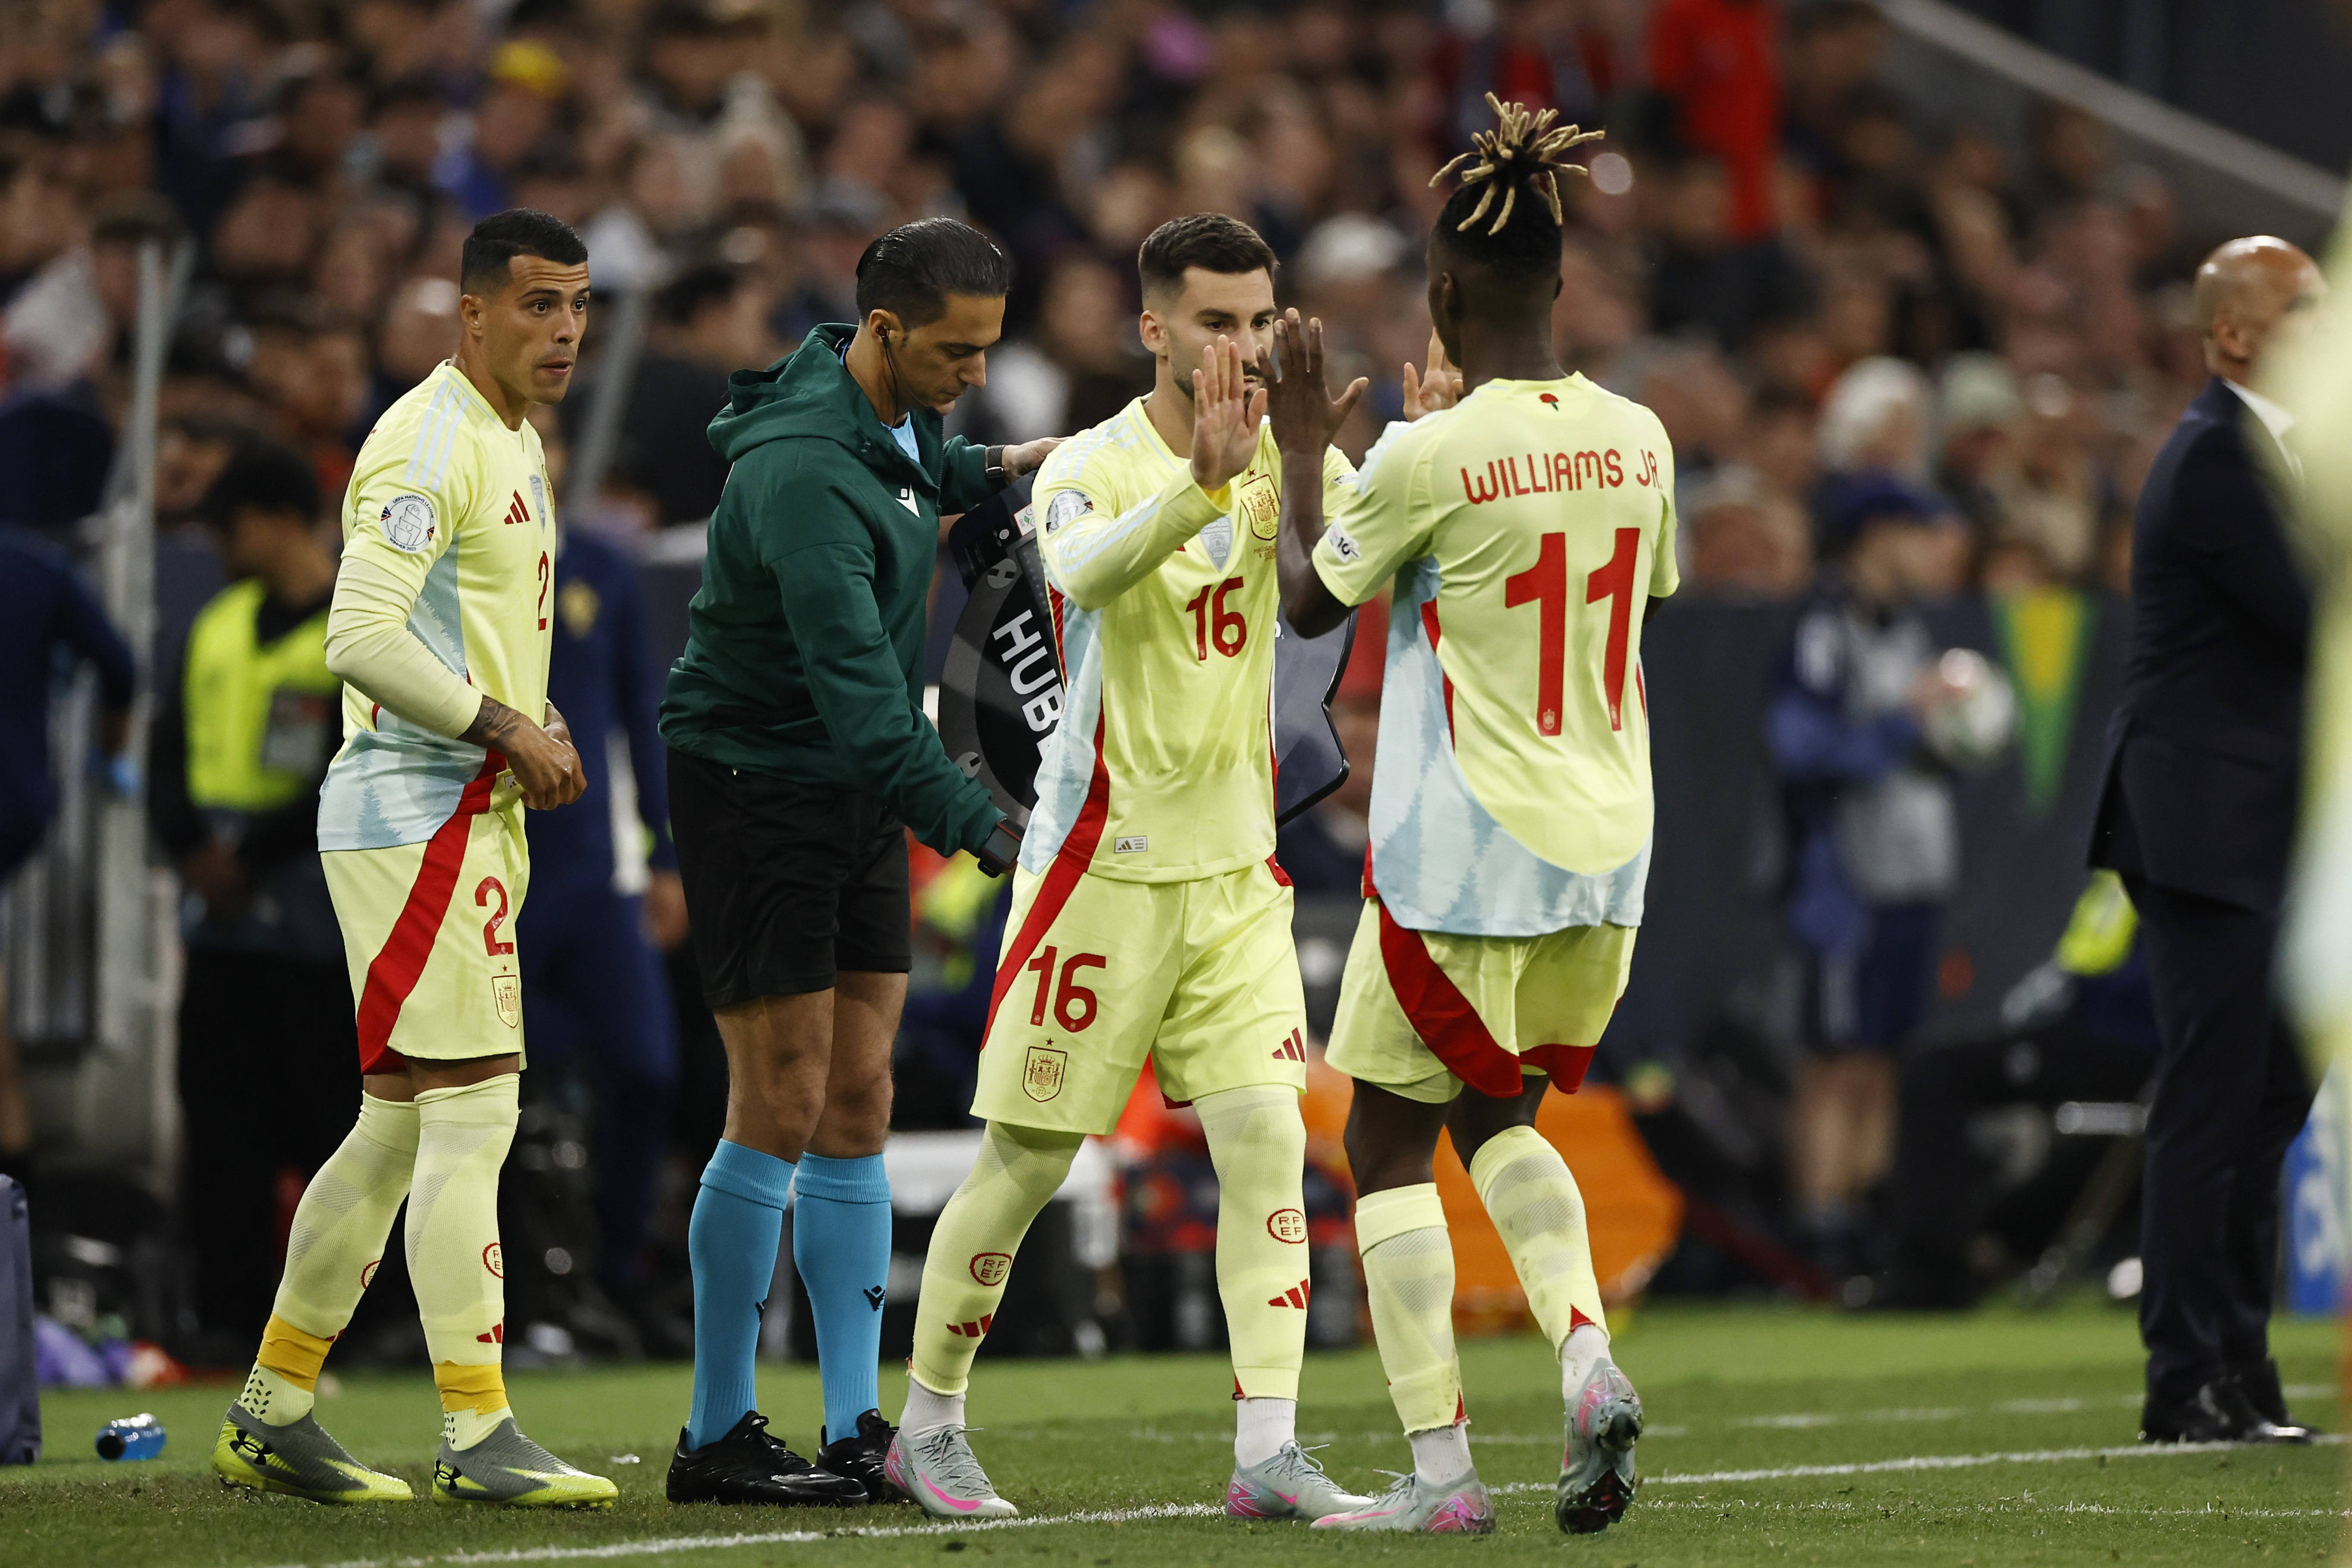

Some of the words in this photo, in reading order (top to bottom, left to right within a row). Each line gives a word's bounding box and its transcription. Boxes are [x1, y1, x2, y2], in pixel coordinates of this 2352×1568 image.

[1460, 448, 1624, 505] WILLIAMS
[405, 495, 425, 503] NATIONS
[390, 537, 406, 549] WINNER
[538, 551, 549, 631] 2
[1185, 576, 1247, 661] 16
[1505, 528, 1640, 736] 11
[475, 876, 514, 957] 2
[1028, 945, 1106, 1033] 16
[1279, 1216, 1300, 1225] RF
[1280, 1227, 1302, 1236] EF
[980, 1269, 1003, 1278] EF
[983, 1259, 1007, 1269] RF
